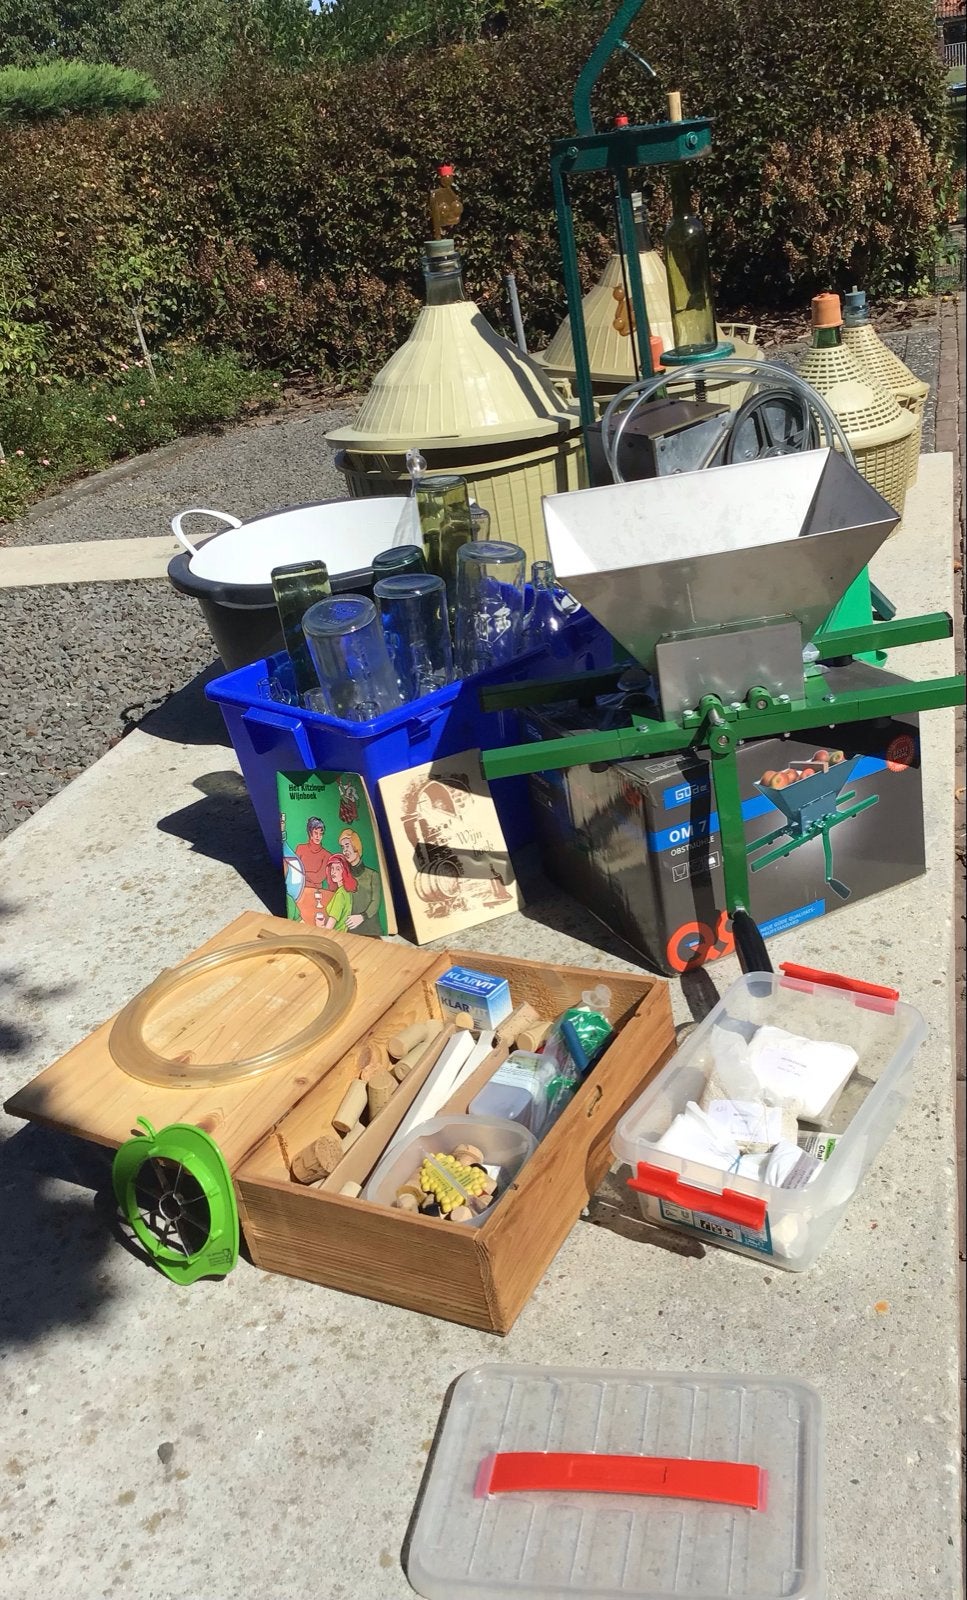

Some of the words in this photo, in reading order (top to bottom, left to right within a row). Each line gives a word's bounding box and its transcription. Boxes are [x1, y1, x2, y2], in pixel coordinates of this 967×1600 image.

[288, 784, 300, 792] Het
[302, 784, 326, 793] Kitzinger
[289, 792, 318, 801] Wijnboek
[456, 829, 482, 845] Wijn
[669, 824, 694, 843] OM
[698, 820, 707, 833] 7
[472, 840, 495, 857] boek
[446, 971, 497, 990] KLARVIT
